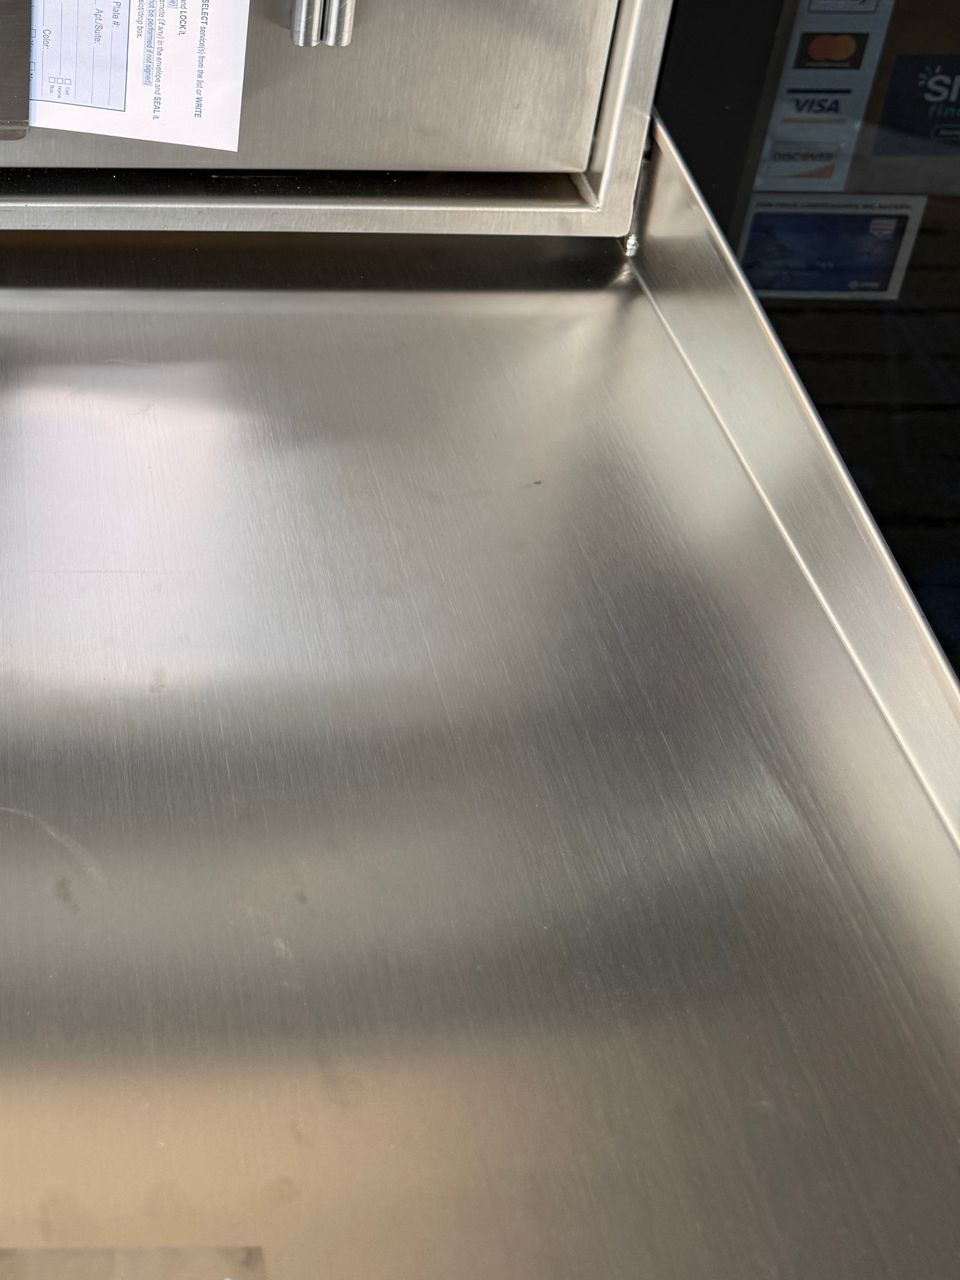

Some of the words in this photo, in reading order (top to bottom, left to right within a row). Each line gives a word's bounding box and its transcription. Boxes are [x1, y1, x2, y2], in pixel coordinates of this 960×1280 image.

[112, 1, 121, 19] Plate
[201, 0, 209, 25] SELECT
[179, 11, 187, 29] LOCK
[42, 29, 51, 49] Color:
[153, 96, 161, 113] SEAL
[792, 98, 840, 113] VISA
